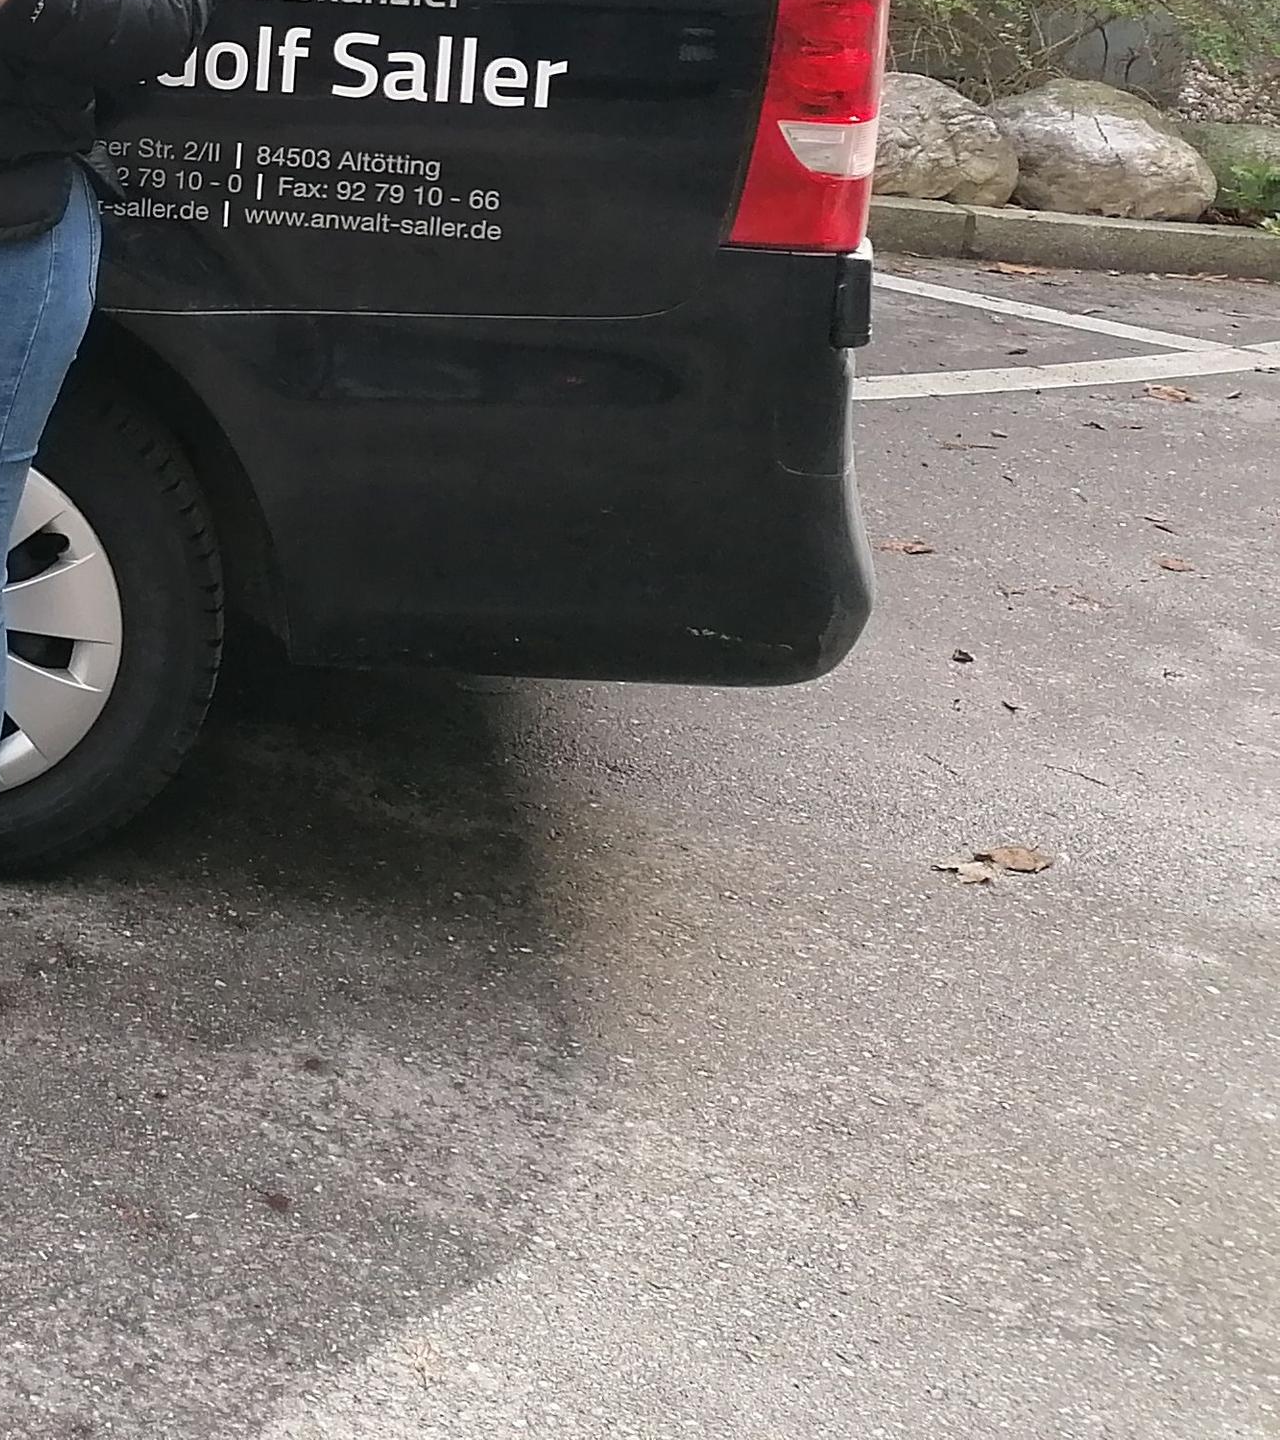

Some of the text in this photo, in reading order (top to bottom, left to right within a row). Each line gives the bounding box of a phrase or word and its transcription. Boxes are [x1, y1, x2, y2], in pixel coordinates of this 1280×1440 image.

[332, 31, 568, 109] Saller
[138, 138, 175, 160] Str.
[256, 147, 331, 170] 84503
[338, 150, 441, 180] Altötting
[138, 168, 167, 188] 79
[175, 170, 203, 191] 10
[228, 174, 242, 193] 0
[279, 177, 329, 200] Fax:
[337, 180, 367, 202] 92
[375, 183, 404, 204] 79
[414, 185, 442, 207] 10
[469, 189, 500, 211] 66
[244, 208, 502, 242] www.anwalt-saller.de
